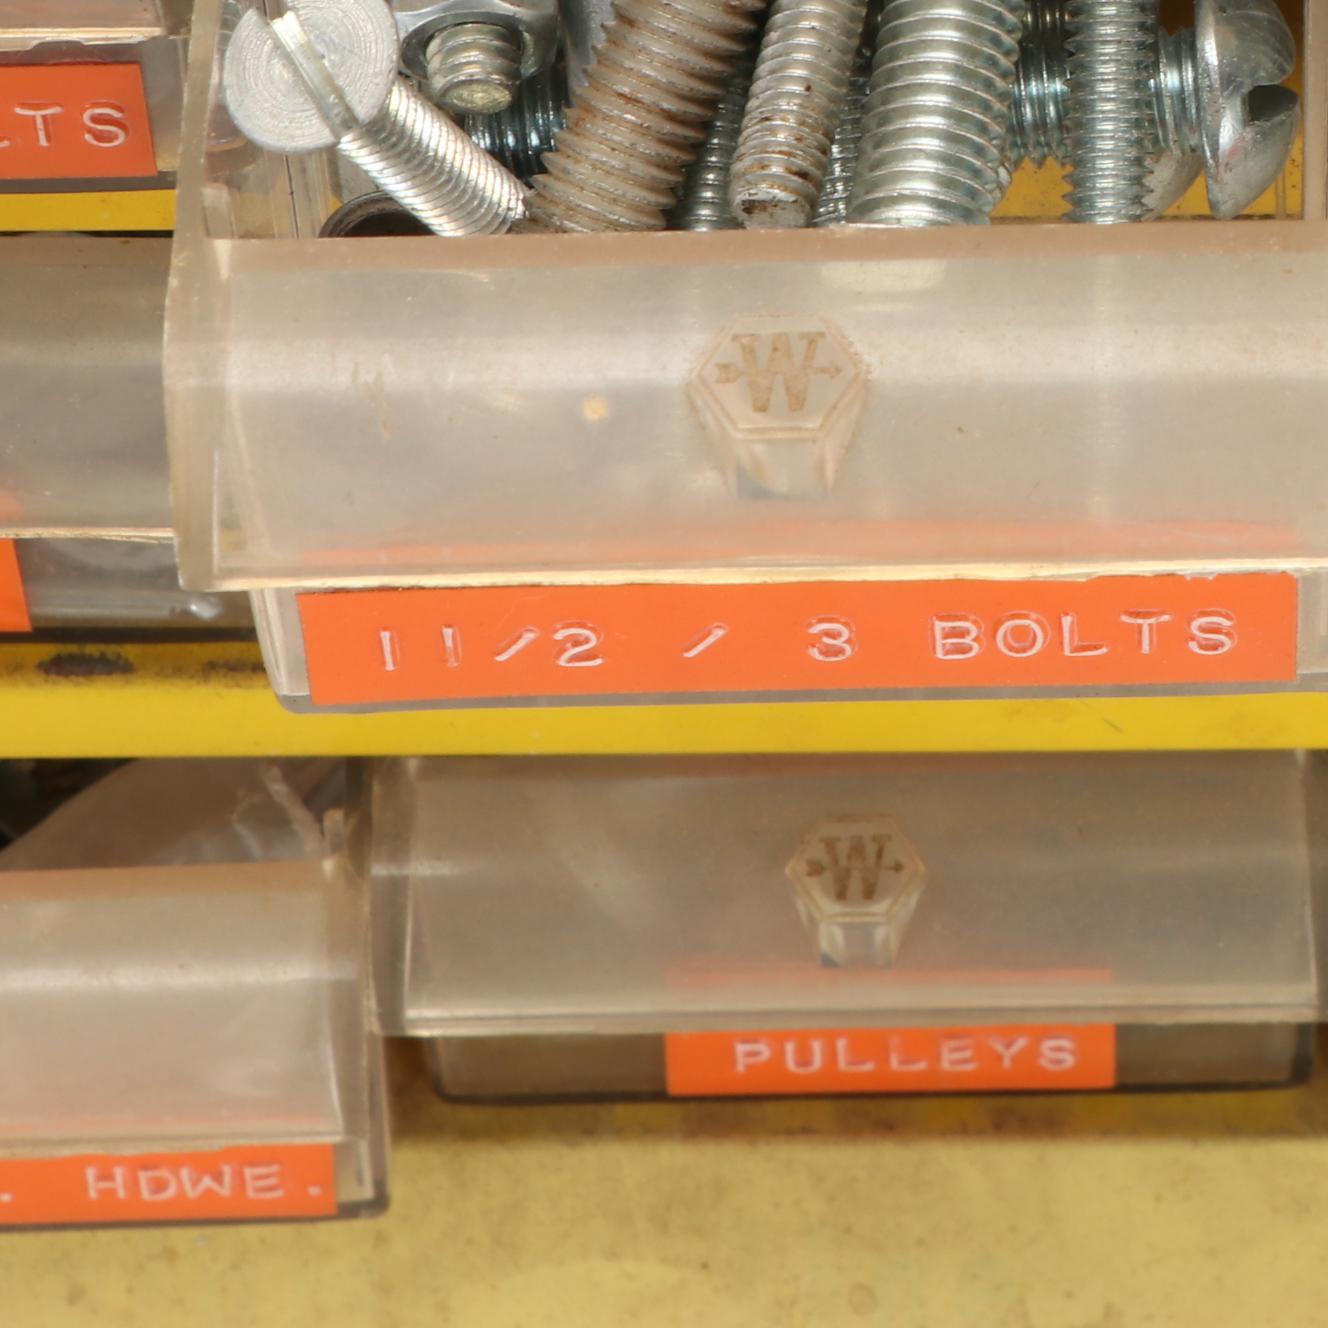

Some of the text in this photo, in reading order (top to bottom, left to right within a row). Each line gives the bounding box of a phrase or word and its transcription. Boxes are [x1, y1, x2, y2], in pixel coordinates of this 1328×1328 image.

[0, 104, 127, 148] TS
[806, 618, 856, 663] 3
[932, 611, 1236, 661] BOLTS
[732, 1034, 1078, 1074] PULLEYS
[84, 1162, 323, 1202] HDWE.
